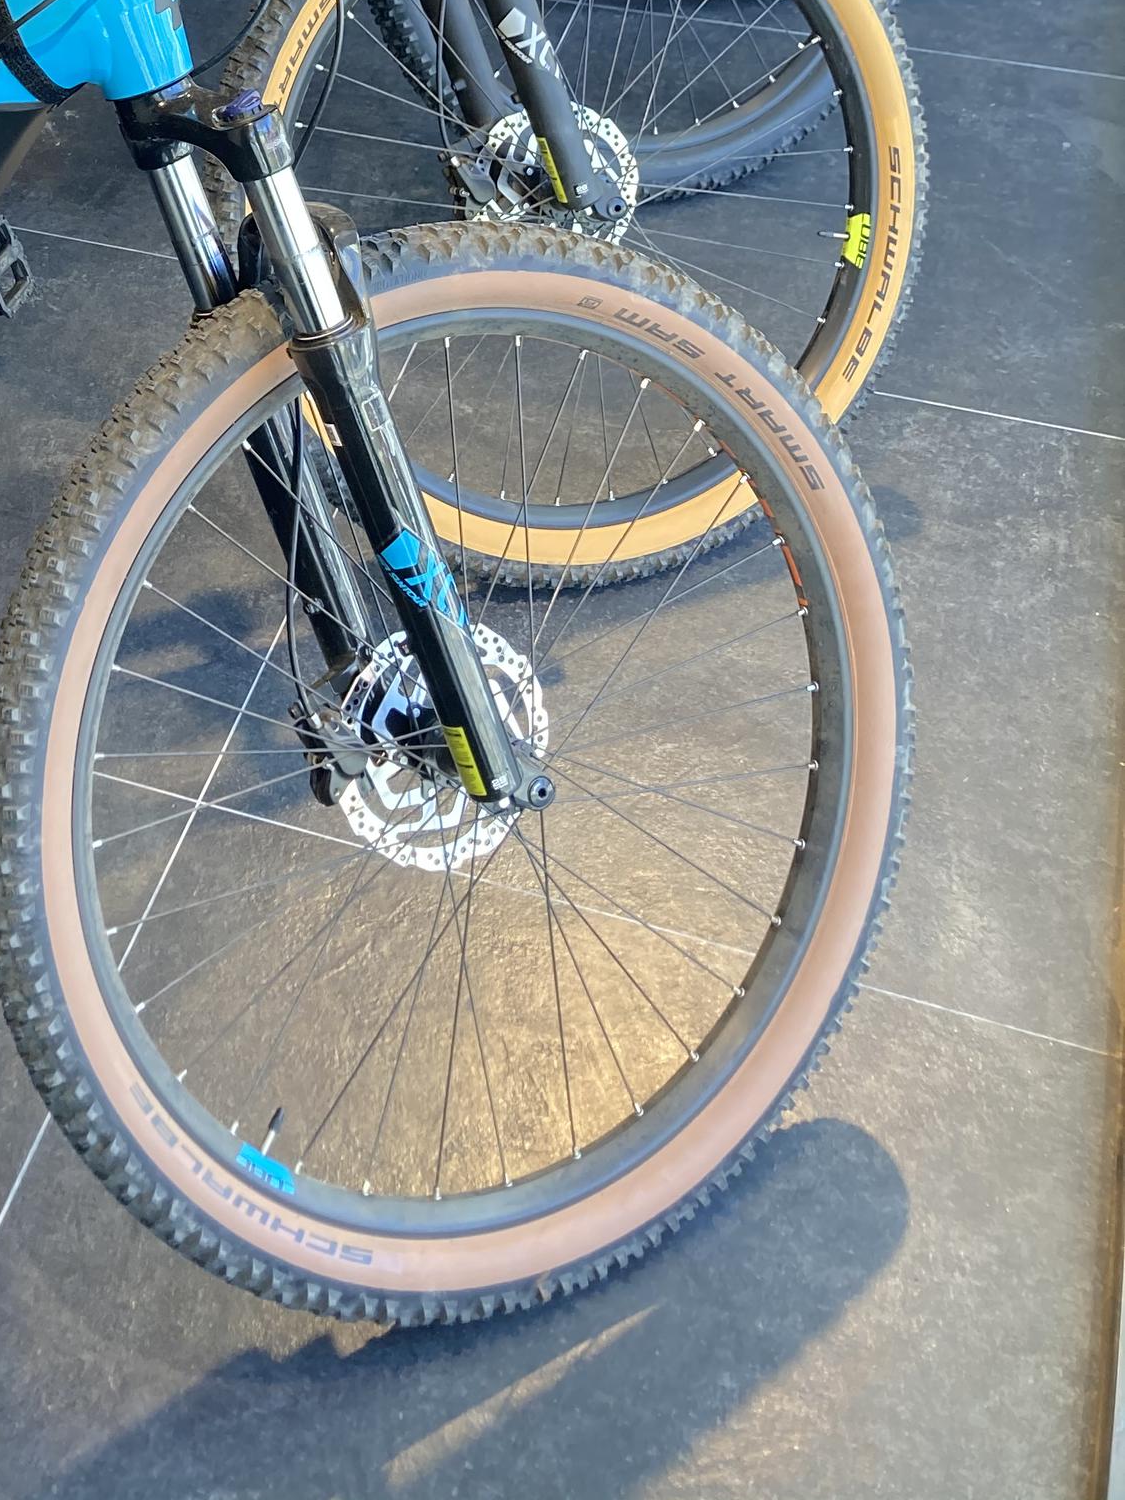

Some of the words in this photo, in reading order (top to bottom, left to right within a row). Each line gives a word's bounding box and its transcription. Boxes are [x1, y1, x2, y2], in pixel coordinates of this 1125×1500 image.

[613, 307, 706, 360] SAM
[841, 145, 902, 383] SCHWALBE
[713, 371, 826, 491] SMART
[129, 1081, 374, 1266] SCHWALBE
